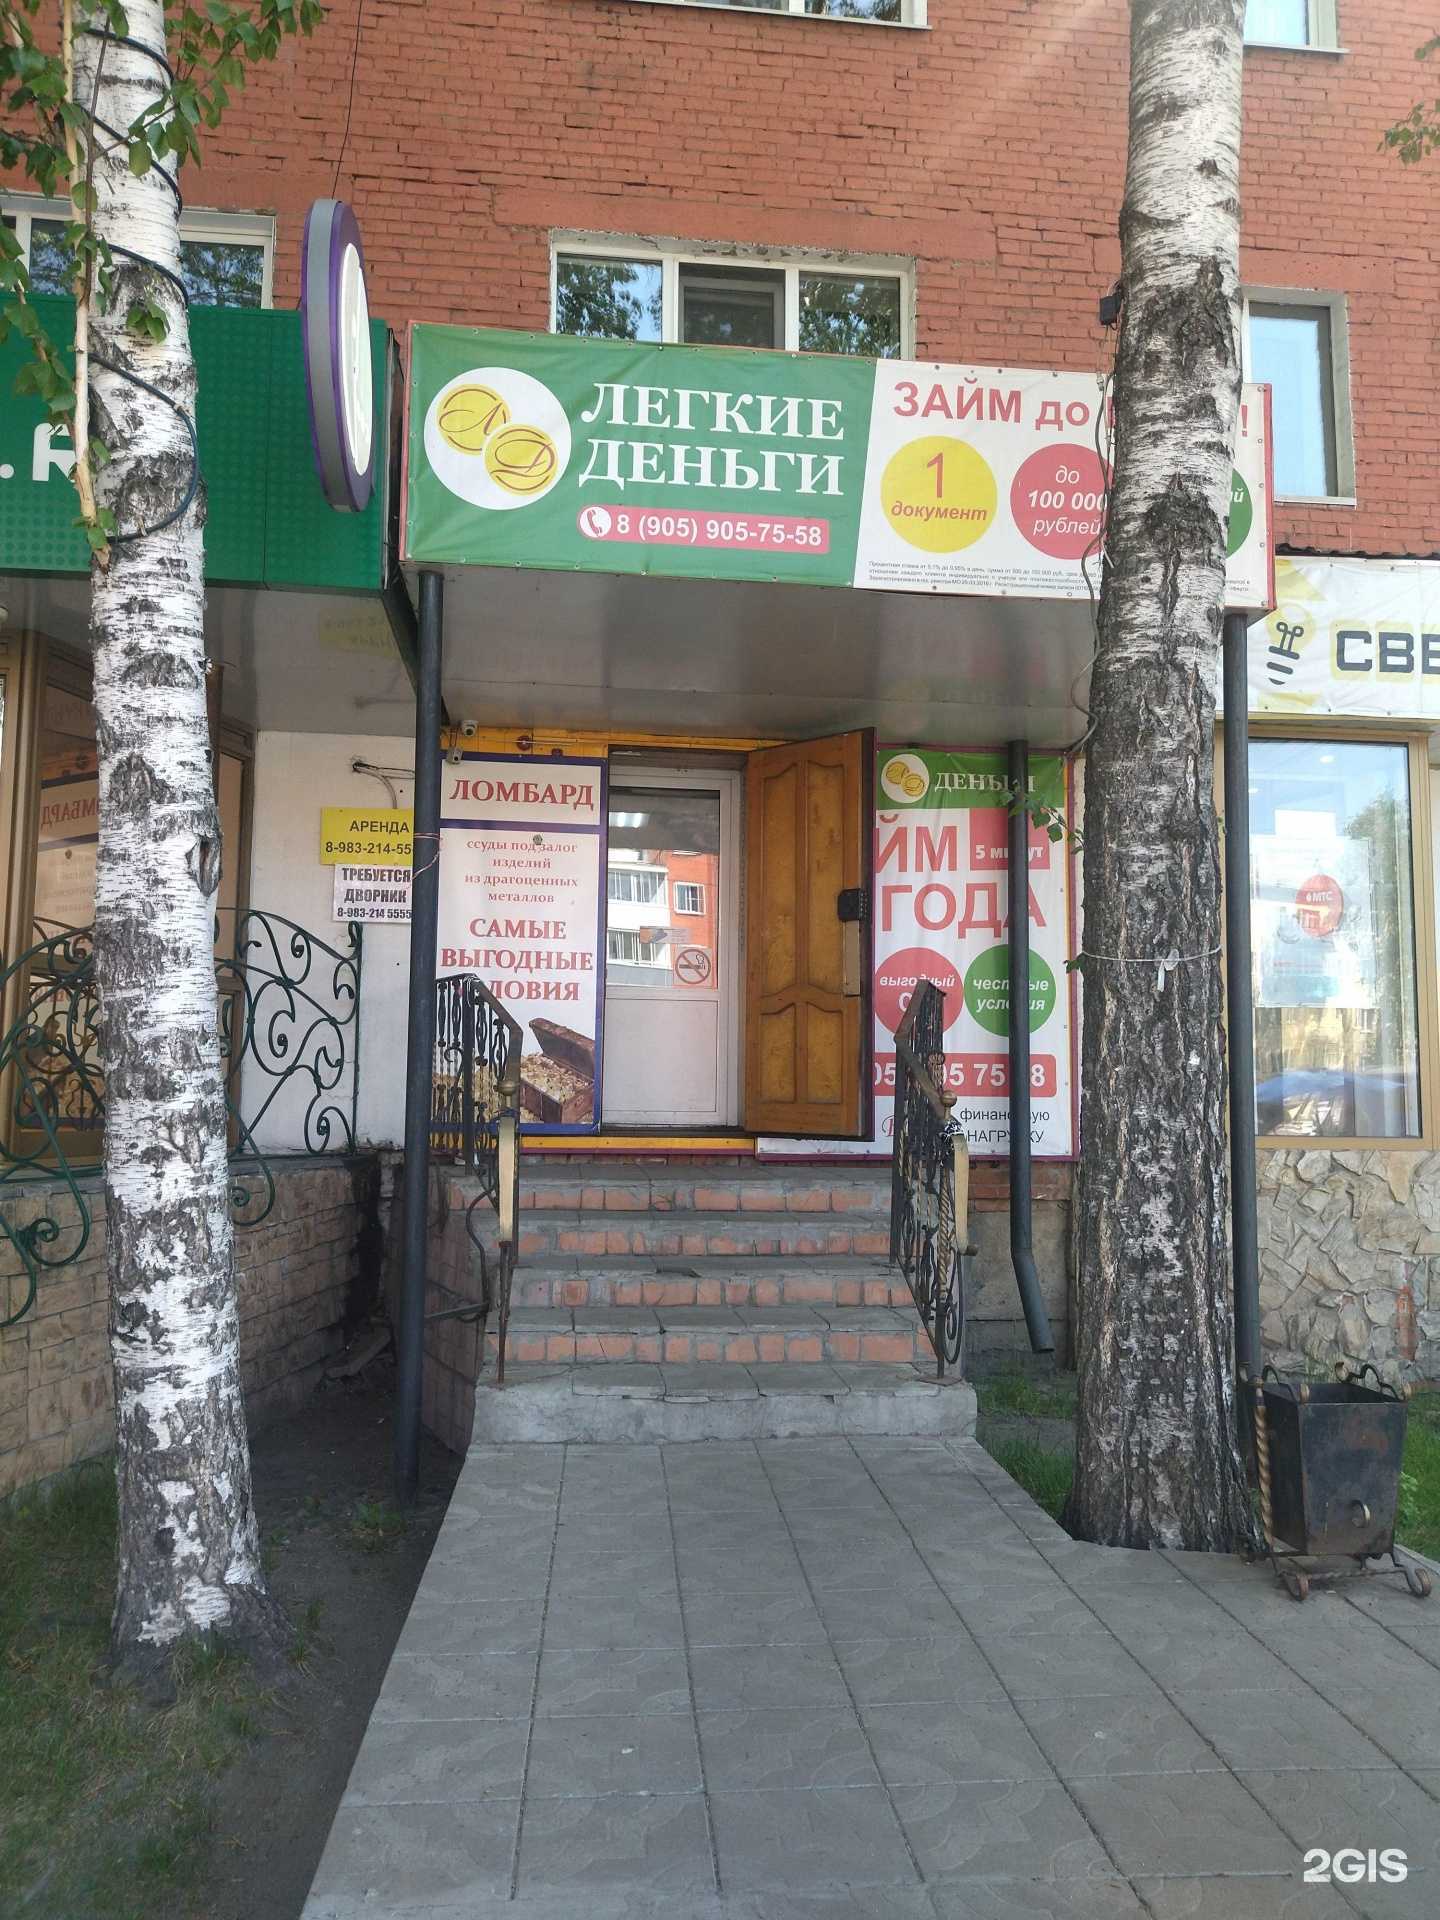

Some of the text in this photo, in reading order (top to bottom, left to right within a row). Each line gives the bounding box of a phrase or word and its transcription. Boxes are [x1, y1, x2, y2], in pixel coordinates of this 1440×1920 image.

[580, 382, 845, 440] ЛЕГКИЕ
[893, 376, 1022, 424] ЗАЙМ
[1035, 401, 1090, 431] до
[578, 438, 845, 496] ДЕНЬГИ
[926, 451, 944, 498] 1
[1055, 465, 1080, 484] до
[1028, 489, 1107, 511] 100 000
[891, 500, 988, 522] документ
[616, 514, 823, 546] 8 (905) 905-75-58
[1033, 516, 1102, 536] рублей
[449, 779, 595, 810] ЛОМБАРД
[349, 820, 410, 835] АРЕНДА
[325, 841, 412, 855] 8-983-214-55
[466, 840, 578, 853] ссуды под залог
[975, 844, 1044, 864] 5 мут
[492, 858, 551, 870] изделий
[341, 867, 411, 882] ТРЕБУЕТСЯ
[464, 874, 578, 887] из драгоценных
[344, 888, 407, 903] ДВОРНИК
[488, 892, 555, 903] металлов
[337, 907, 385, 918] 8-983-214
[469, 918, 567, 939] САМЫЕ
[440, 948, 594, 974] ВЫГОДНЫЕ
[488, 980, 580, 1001] ЛОВИЯ
[972, 977, 1049, 990] честые
[973, 1063, 1006, 1087] 75
